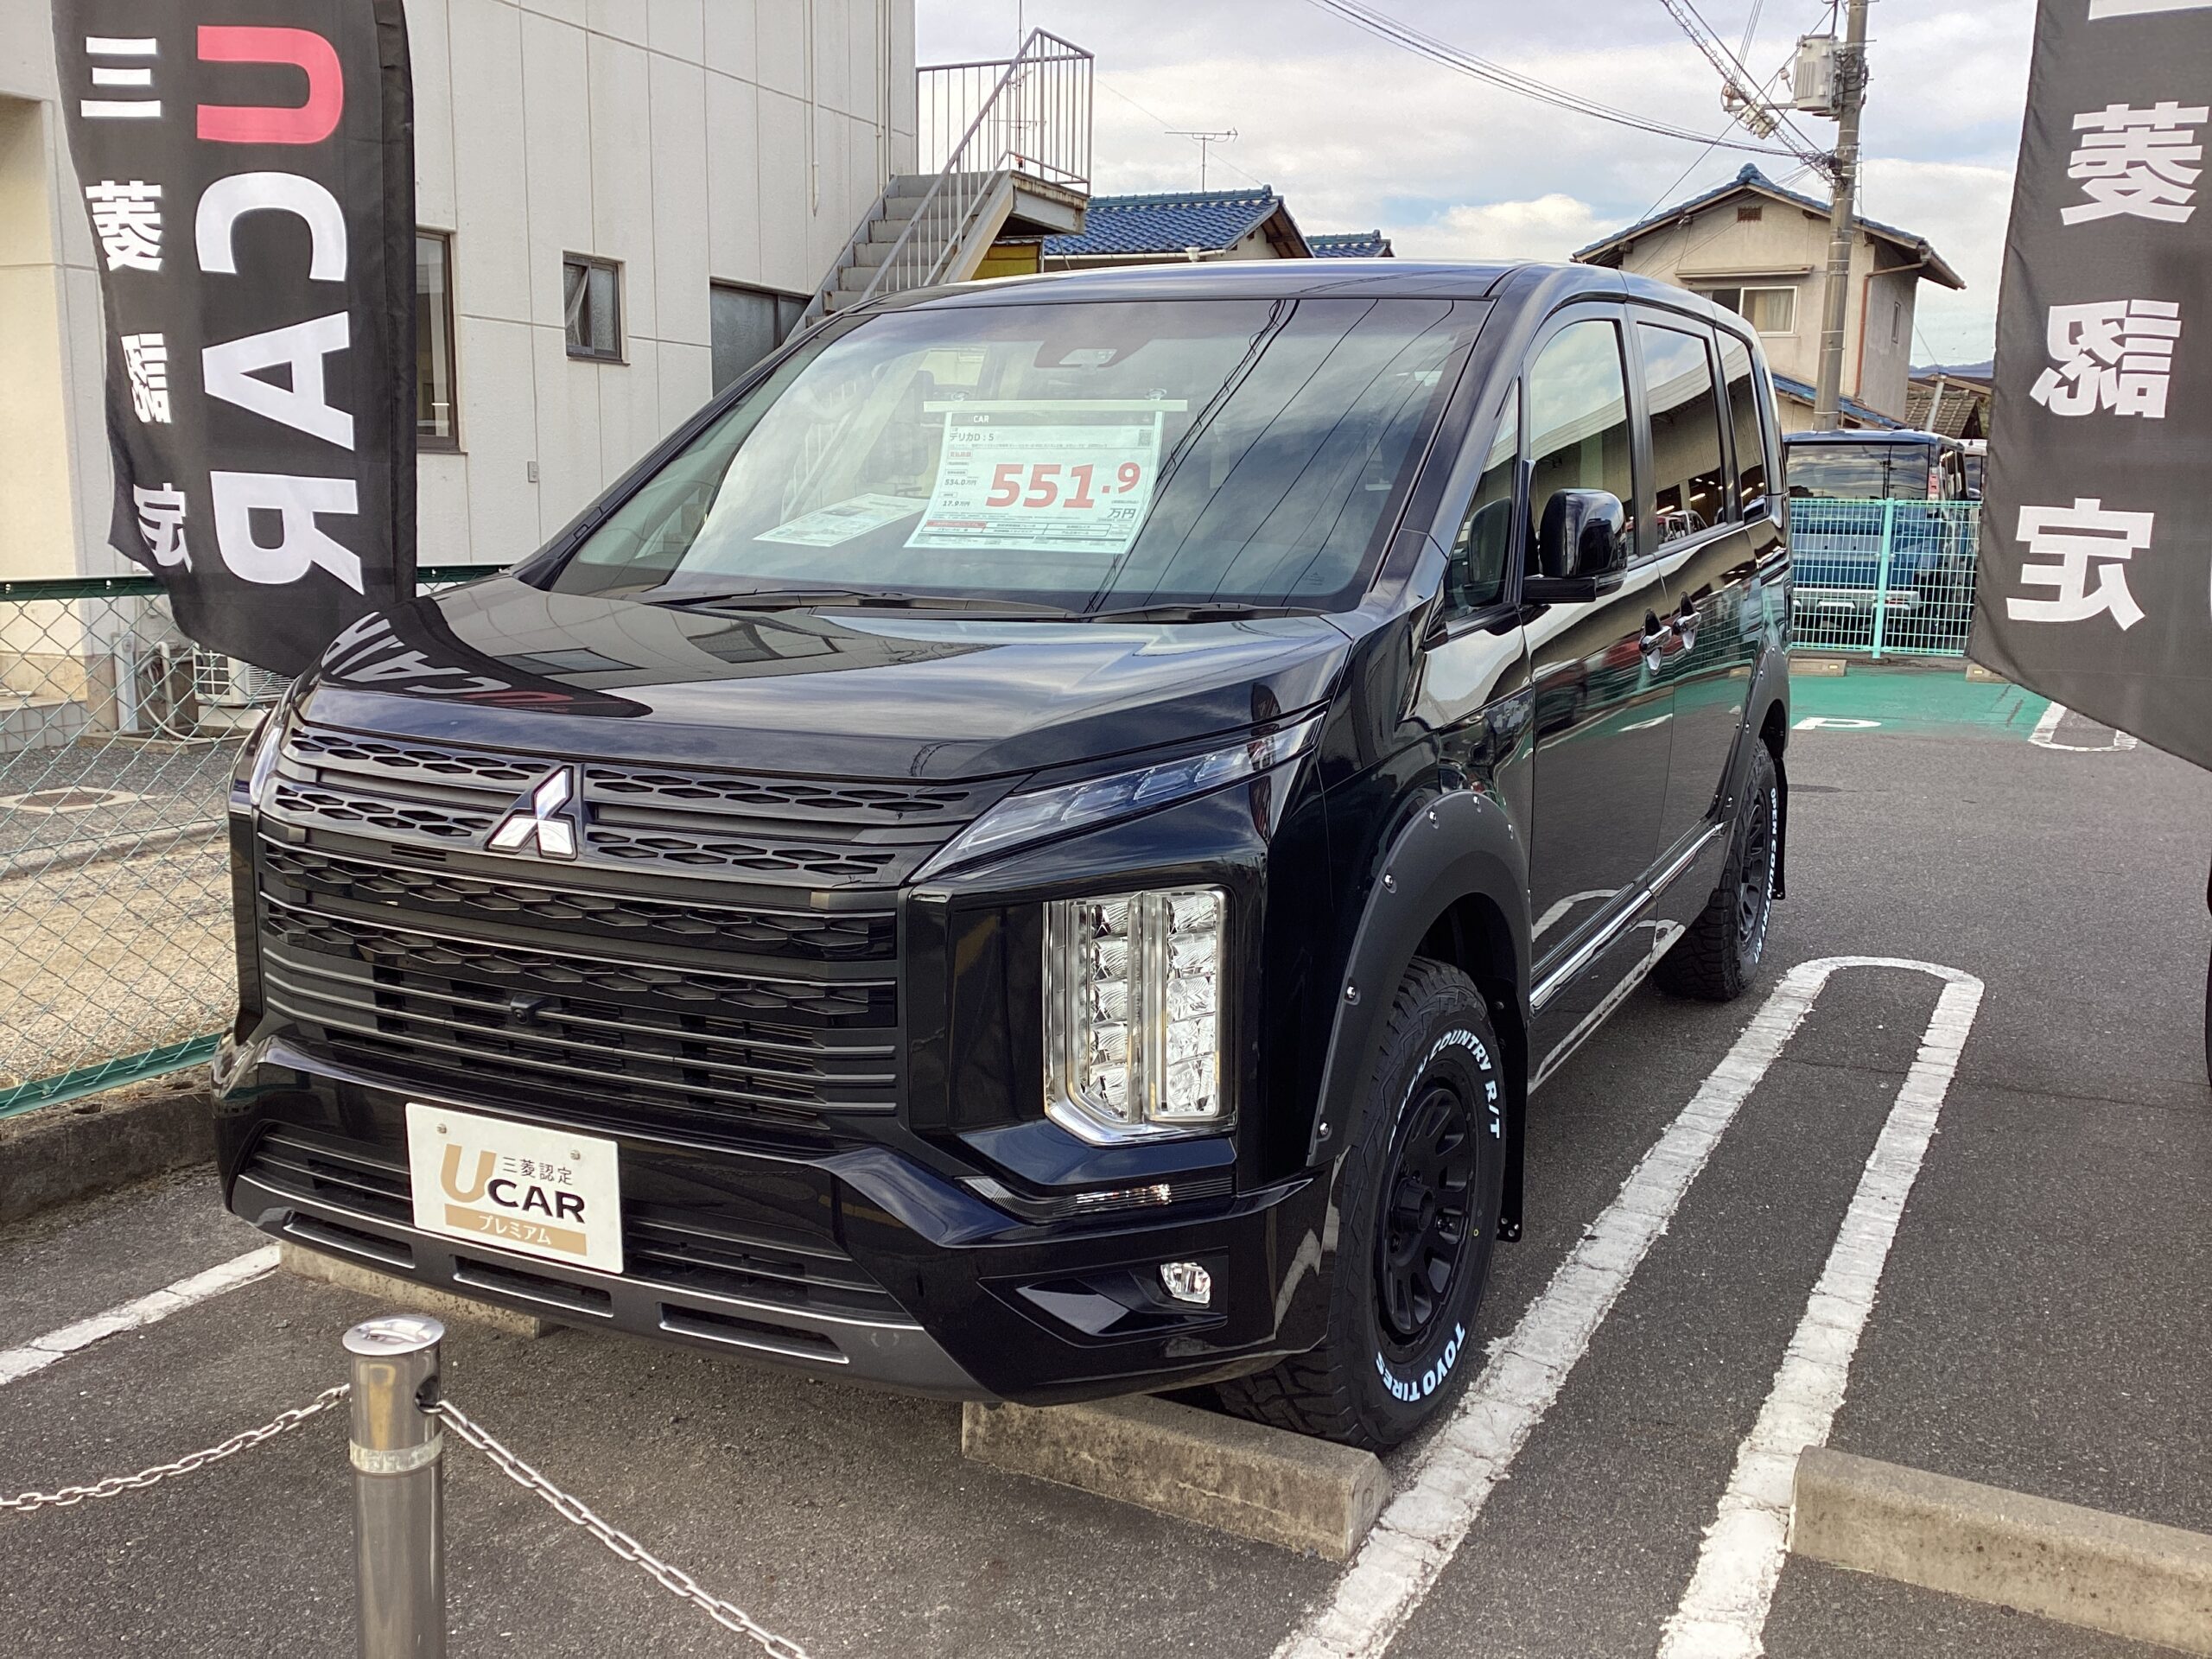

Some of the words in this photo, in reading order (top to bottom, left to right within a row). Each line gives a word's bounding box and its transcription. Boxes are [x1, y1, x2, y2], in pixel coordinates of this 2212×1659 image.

[985, 461, 1141, 508] 551.9
[1107, 508, 1137, 519] 万円
[1429, 1028, 1492, 1071] COUNTRY
[1484, 1080, 1500, 1139] R/T
[502, 1155, 573, 1186] 三菱認定
[478, 1214, 552, 1245] プレミアム
[1376, 1351, 1421, 1402] TIRES
[1422, 1321, 1466, 1396] TOYO
